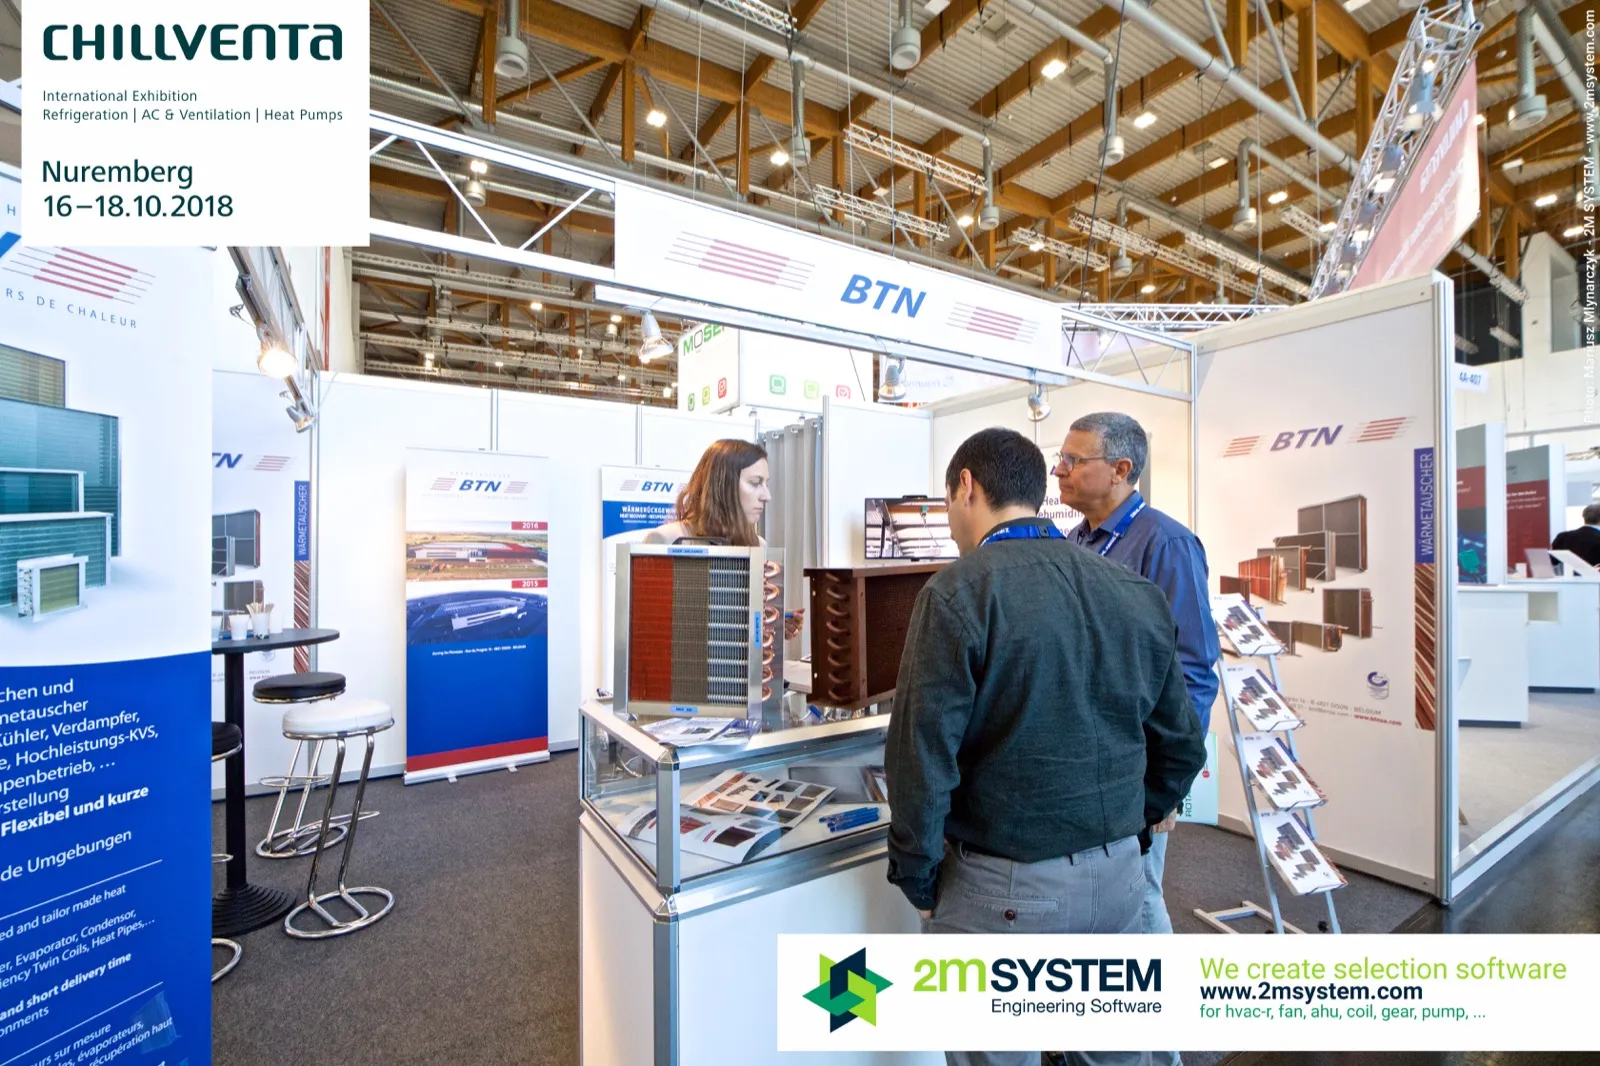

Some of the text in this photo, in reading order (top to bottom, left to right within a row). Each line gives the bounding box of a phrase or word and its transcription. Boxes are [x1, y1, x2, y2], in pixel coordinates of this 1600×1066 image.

[36, 296, 56, 310] DE
[67, 304, 136, 328] CHALEUR
[840, 274, 927, 318] BTN
[1270, 424, 1344, 452] BTN
[459, 479, 502, 492] BTN
[641, 481, 674, 492] BTN
[1043, 496, 1061, 506] Hea
[1419, 452, 1434, 556] WÄRMETAUSCHER
[298, 484, 308, 556] WÄRMETAUSCHER
[42, 678, 74, 696] und
[52, 710, 140, 737] Verdampfer,
[16, 725, 158, 767] Hochleistungs-KVS,
[0, 786, 149, 837] Flexibel und kurze
[27, 830, 132, 873] Umgebungen
[17, 916, 39, 935] and
[42, 906, 70, 924] tailor
[72, 894, 102, 912] made
[104, 884, 126, 900] heat
[16, 933, 79, 967] Evaporator,
[80, 909, 137, 938] Condensor,
[32, 955, 60, 974] Twin
[62, 942, 90, 961] Coils,
[92, 930, 116, 949] Heat
[0, 952, 132, 1020] and short delivery time
[54, 1044, 72, 1061] sur
[73, 1024, 112, 1050] mesure
[78, 1021, 144, 1062] évaporateurs,
[151, 1016, 173, 1035] haut
